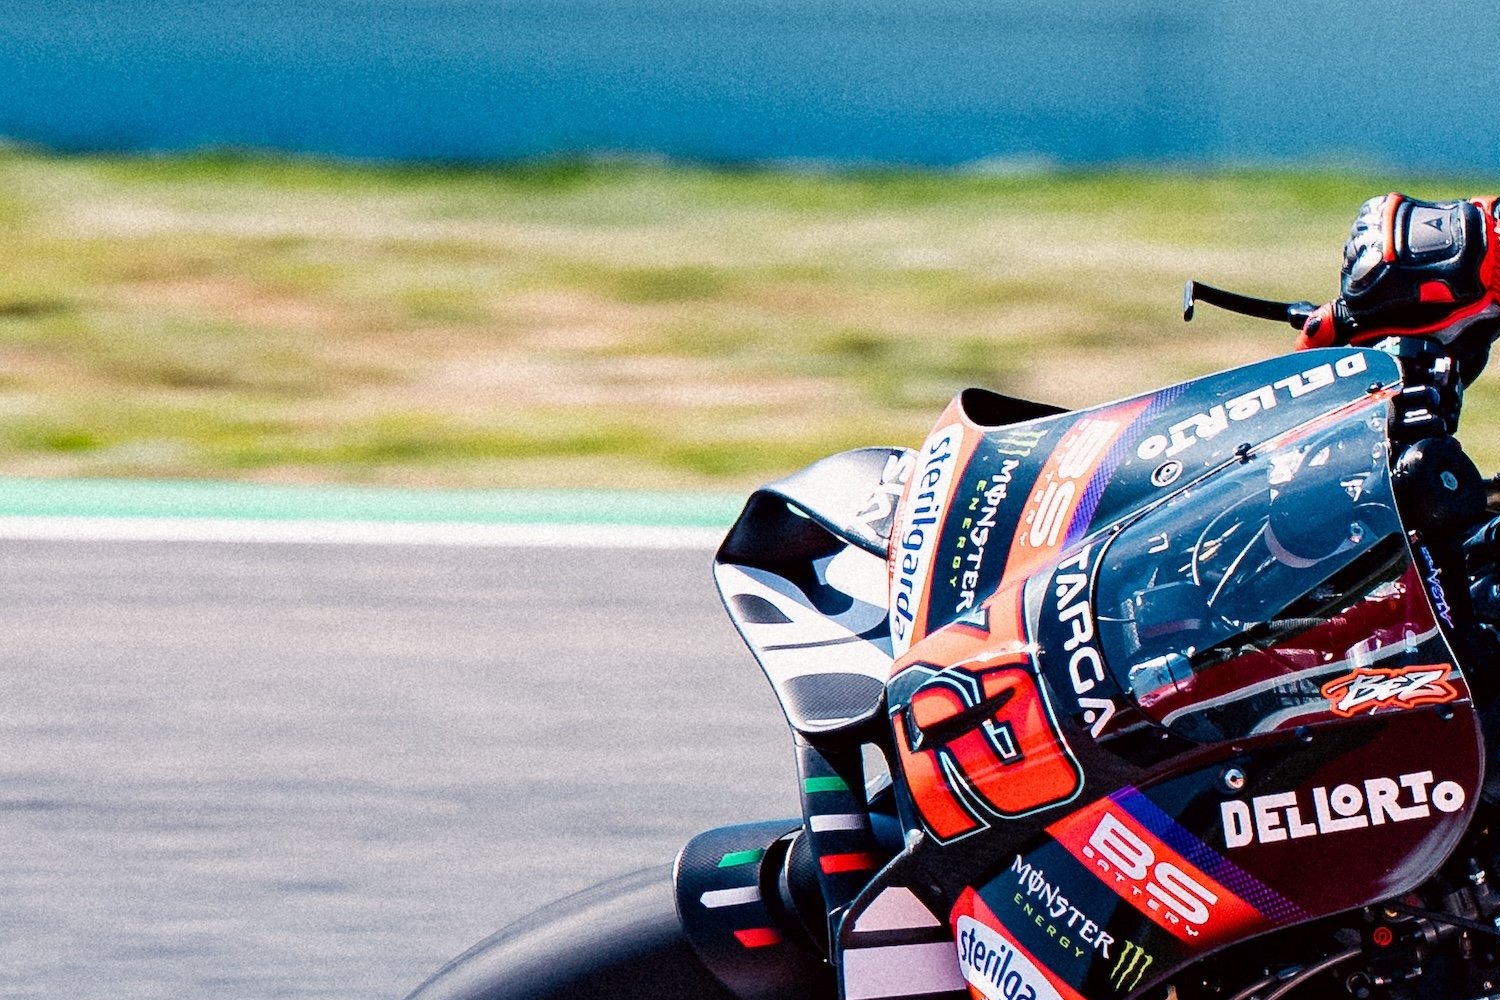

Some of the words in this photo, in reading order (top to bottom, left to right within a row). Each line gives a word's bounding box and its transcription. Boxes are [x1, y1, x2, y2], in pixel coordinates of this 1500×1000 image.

[894, 436, 951, 641] sterilgarda
[949, 479, 988, 588] ENERGY
[955, 459, 1020, 613] MONSTER
[1220, 770, 1466, 849] DELLORTO
[1011, 854, 1115, 959] MONSTER
[1081, 845, 1200, 937] BATTERY
[1087, 811, 1220, 925] BS
[1013, 892, 1085, 958] ENERGY
